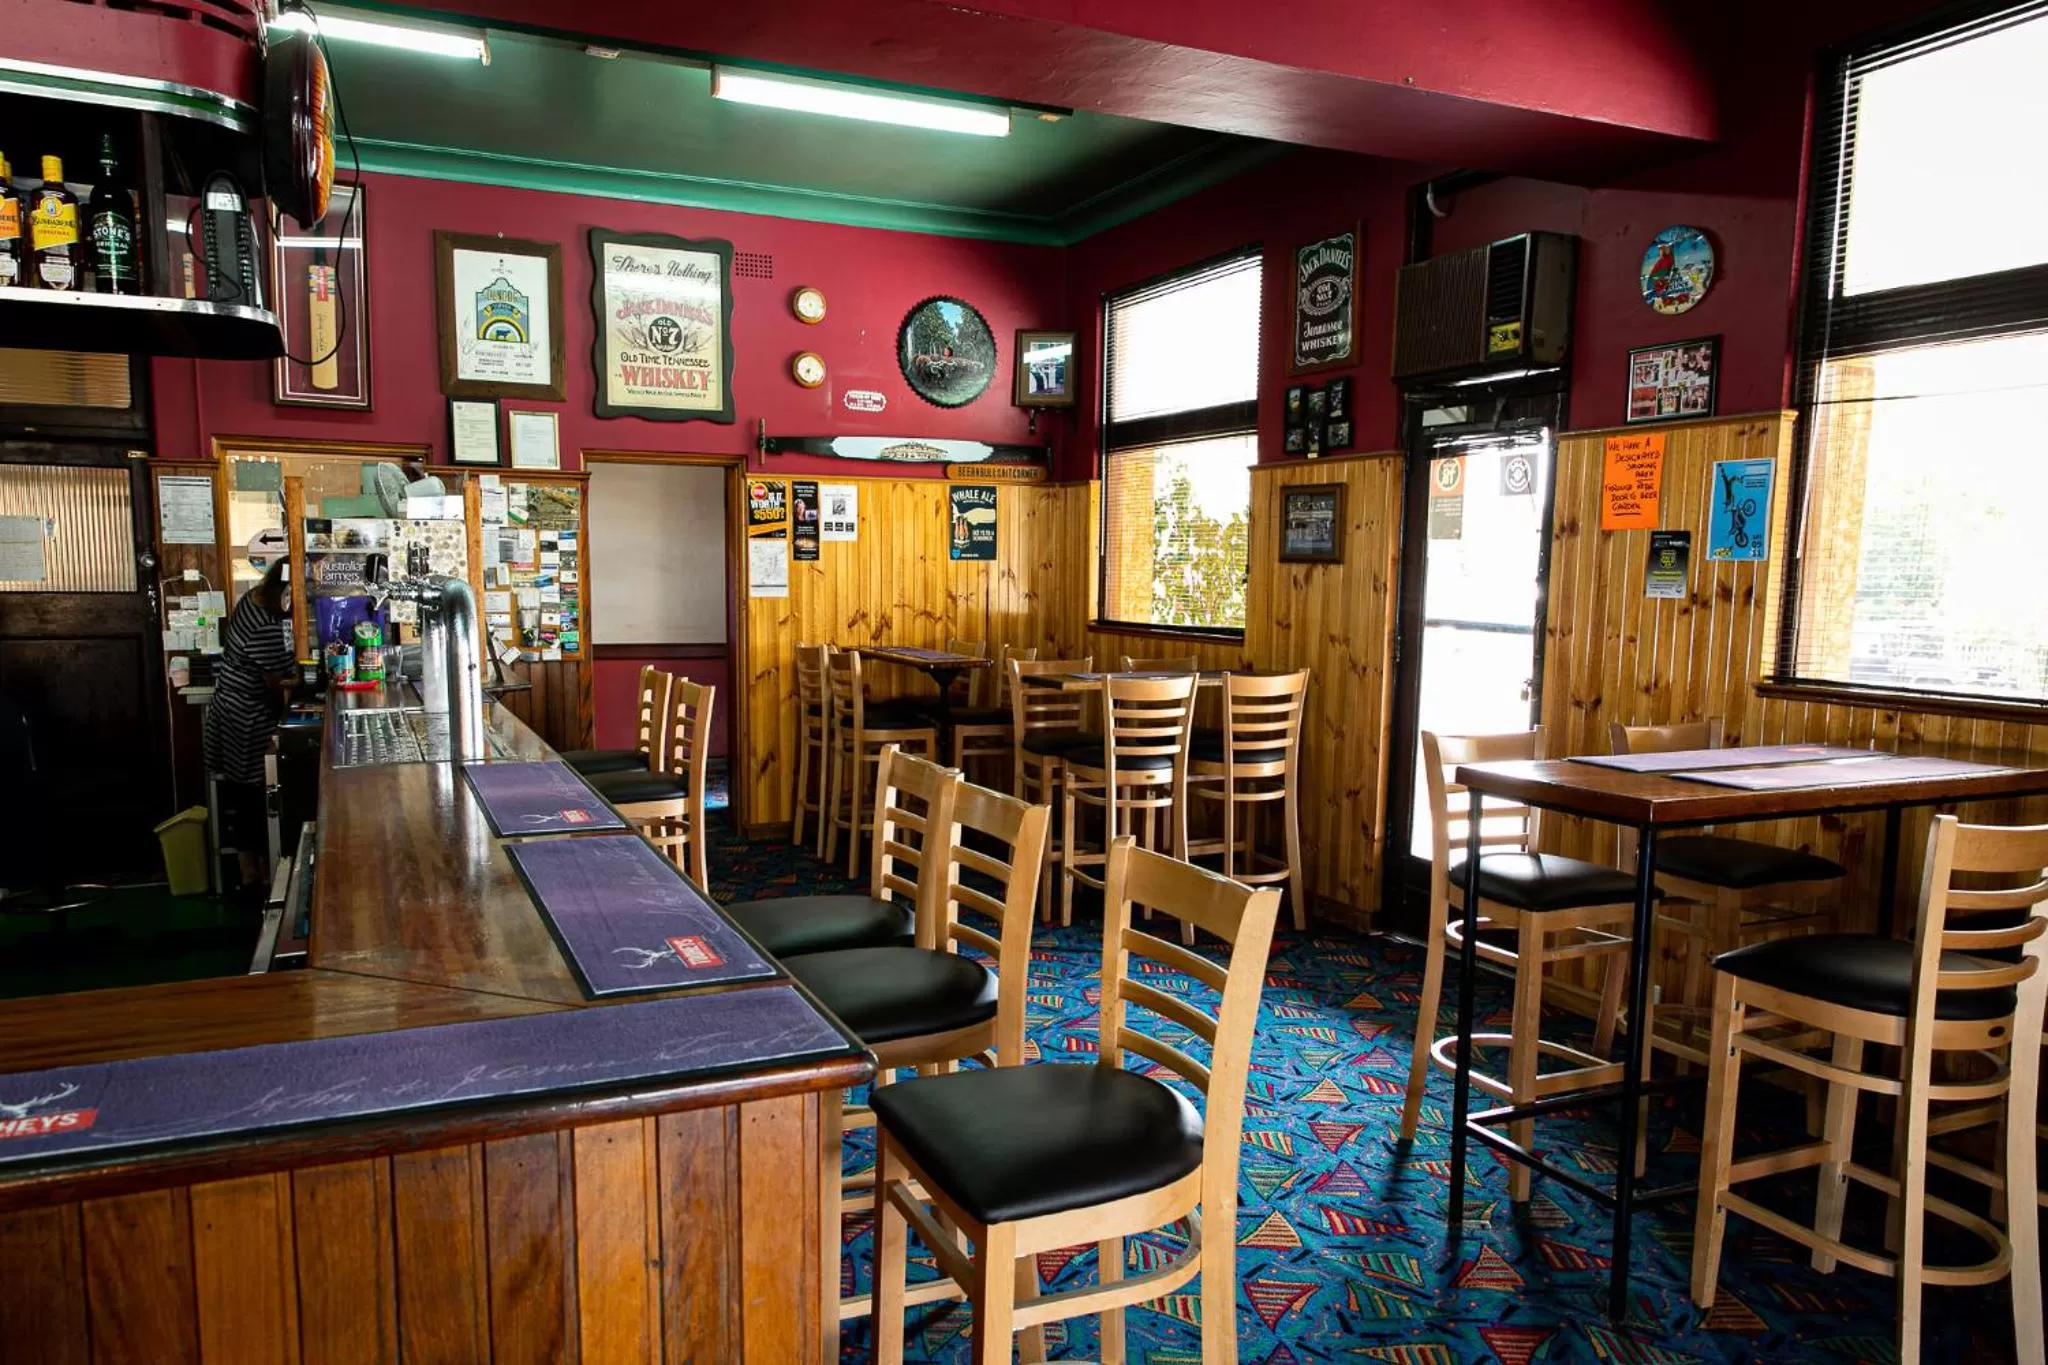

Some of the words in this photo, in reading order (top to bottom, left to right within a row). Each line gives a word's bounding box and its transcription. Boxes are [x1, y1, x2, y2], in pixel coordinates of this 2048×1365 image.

[93, 225, 131, 241] STONE'S
[667, 260, 712, 283] Nothing
[1302, 333, 1345, 352] WHISKEY
[620, 351, 640, 362] OLD
[639, 353, 661, 365] TIME
[662, 354, 711, 368] TENNESSEE
[620, 365, 711, 391] WHISKEY
[1626, 462, 1657, 471] SMOKING
[952, 489, 980, 503] WHALE
[981, 491, 996, 504] ALE
[754, 507, 785, 520] $550?
